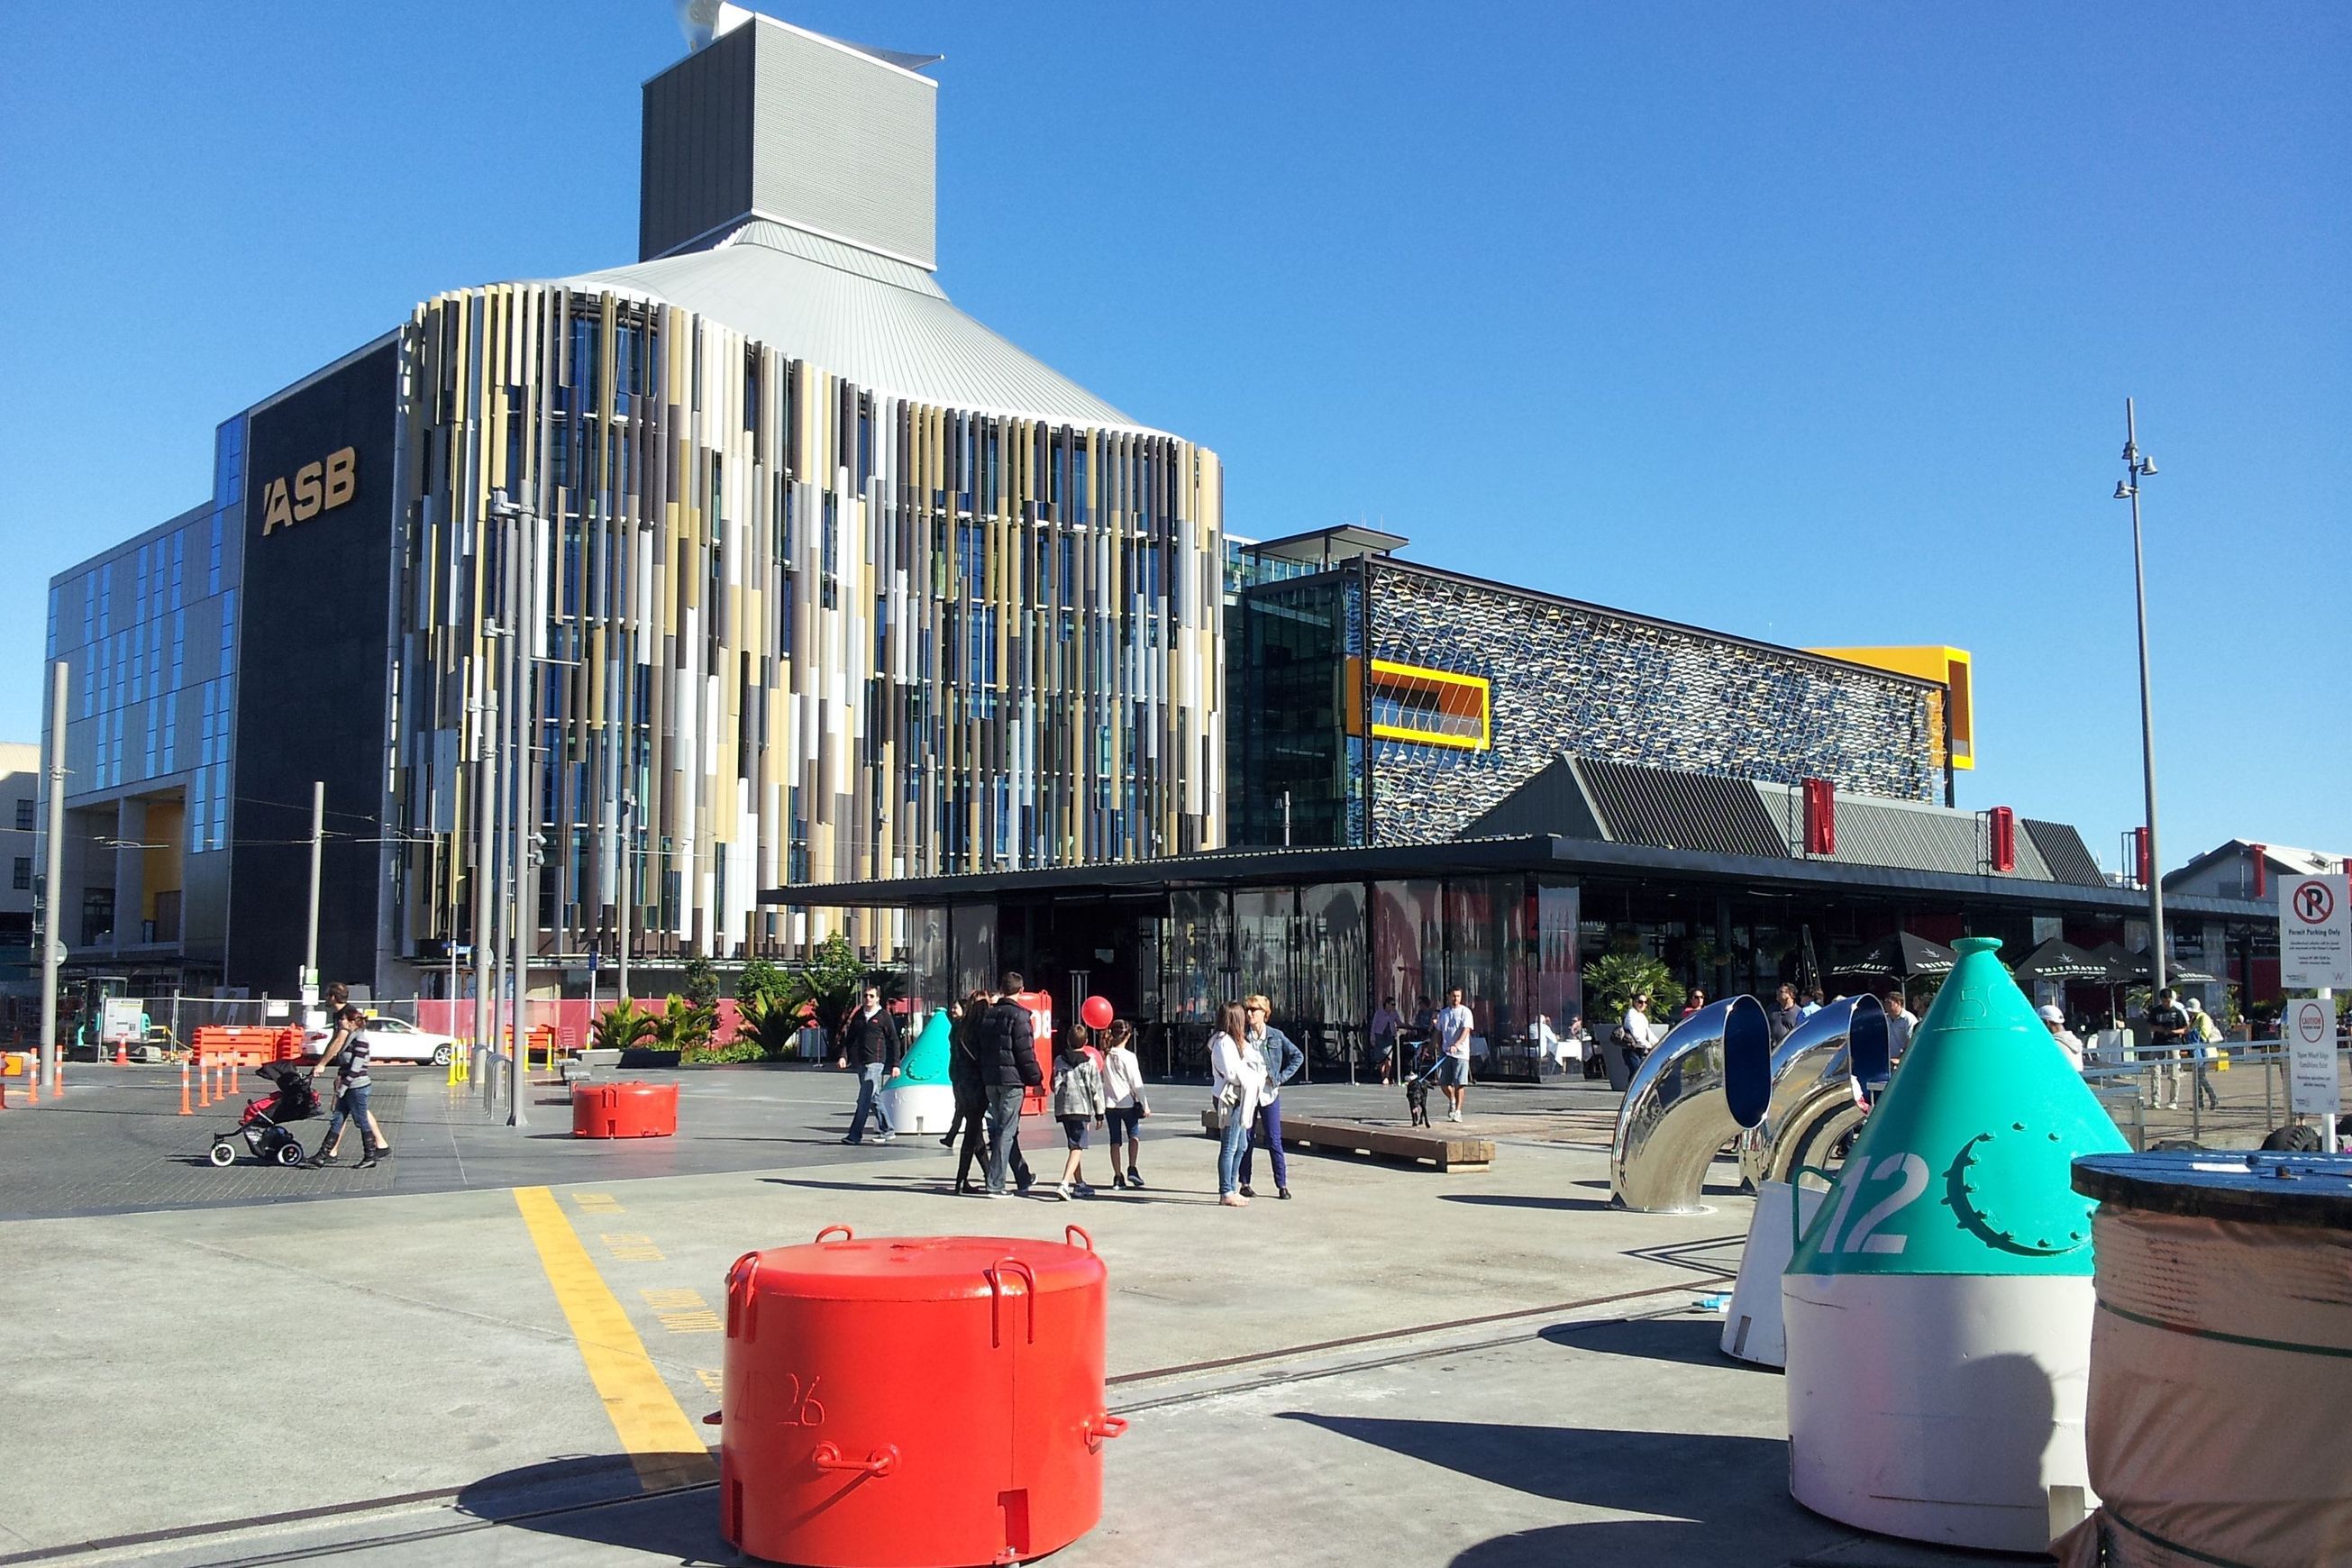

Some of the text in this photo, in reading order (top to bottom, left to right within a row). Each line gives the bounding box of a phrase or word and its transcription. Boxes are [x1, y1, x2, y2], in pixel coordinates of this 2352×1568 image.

[262, 446, 356, 536] ASB
[2307, 928, 2327, 937] Parking
[2328, 928, 2341, 936] Only
[2034, 964, 2107, 973] WHITEHAVEN
[1819, 1153, 1929, 1253] 12
